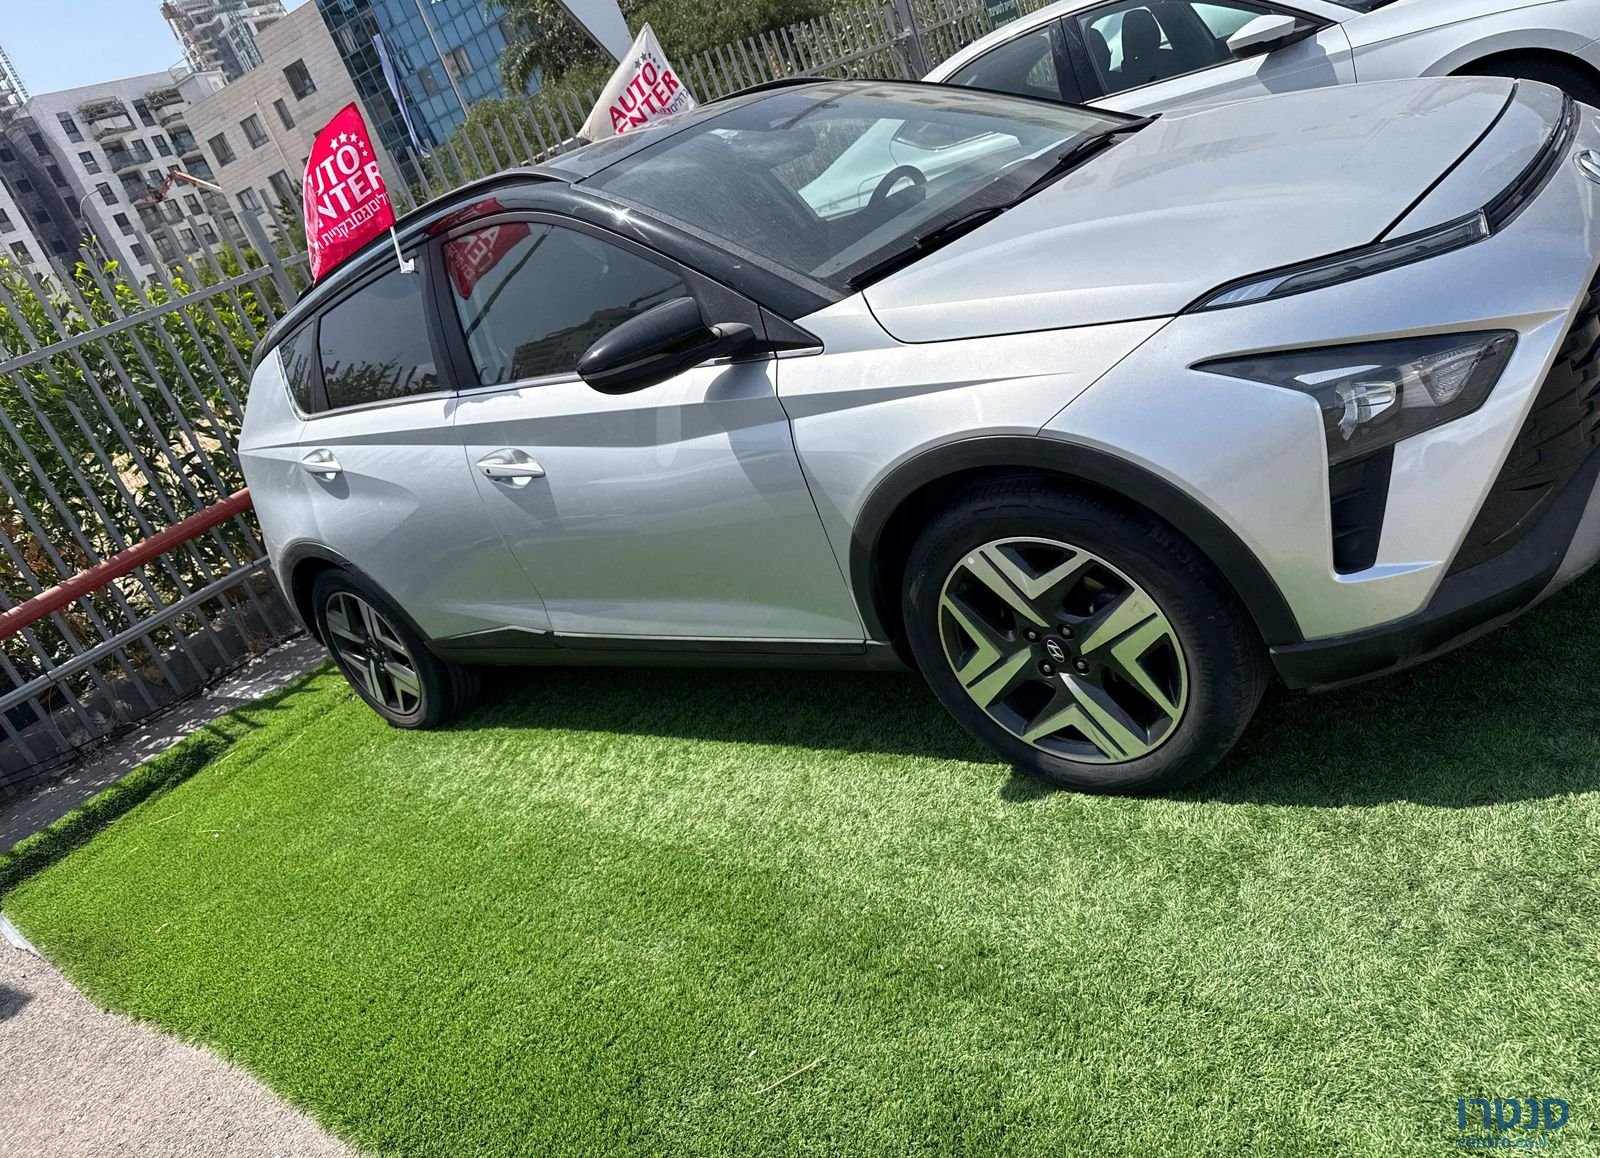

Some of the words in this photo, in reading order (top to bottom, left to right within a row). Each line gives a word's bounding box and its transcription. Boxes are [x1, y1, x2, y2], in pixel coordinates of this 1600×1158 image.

[609, 62, 658, 130] AUTO
[308, 144, 361, 196] UTO
[317, 160, 383, 228] NTER
